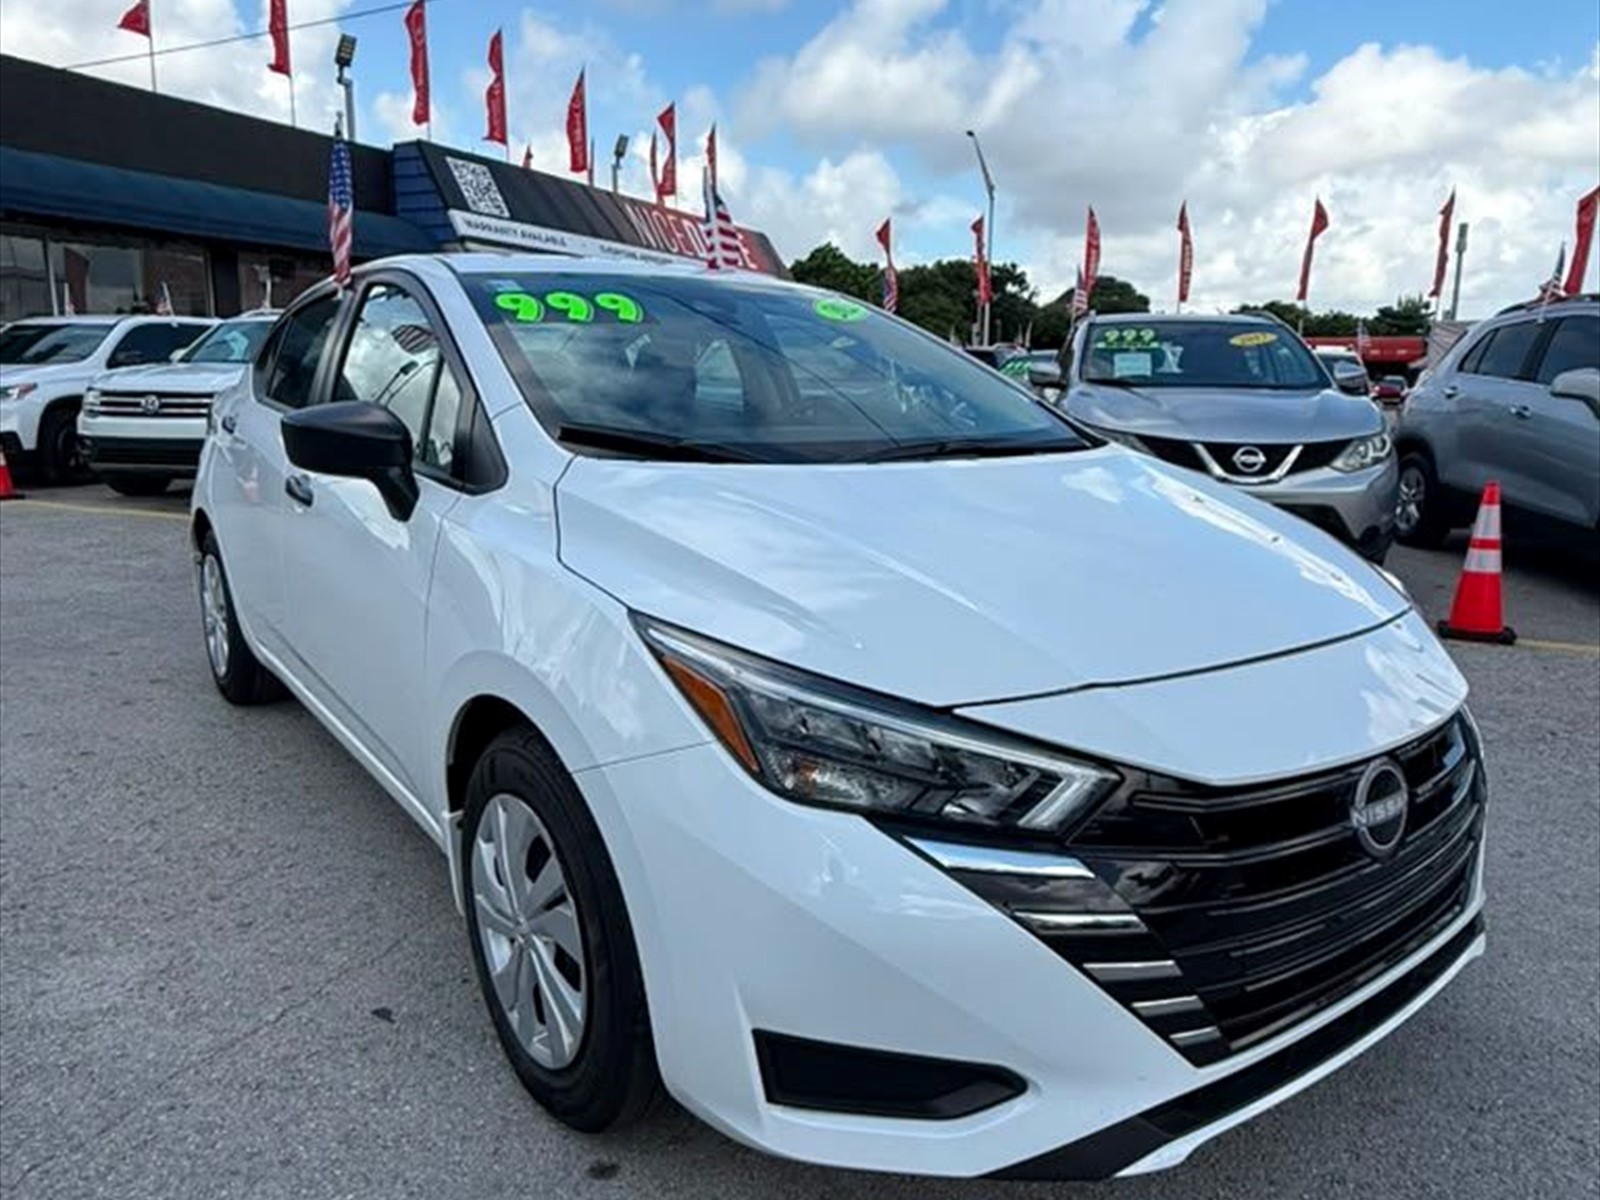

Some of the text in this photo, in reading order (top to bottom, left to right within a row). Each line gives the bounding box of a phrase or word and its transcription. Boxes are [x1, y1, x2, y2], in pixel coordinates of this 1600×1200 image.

[624, 203, 758, 269] NICEDE
[496, 292, 644, 322] 999
[1350, 794, 1405, 829] NISS
